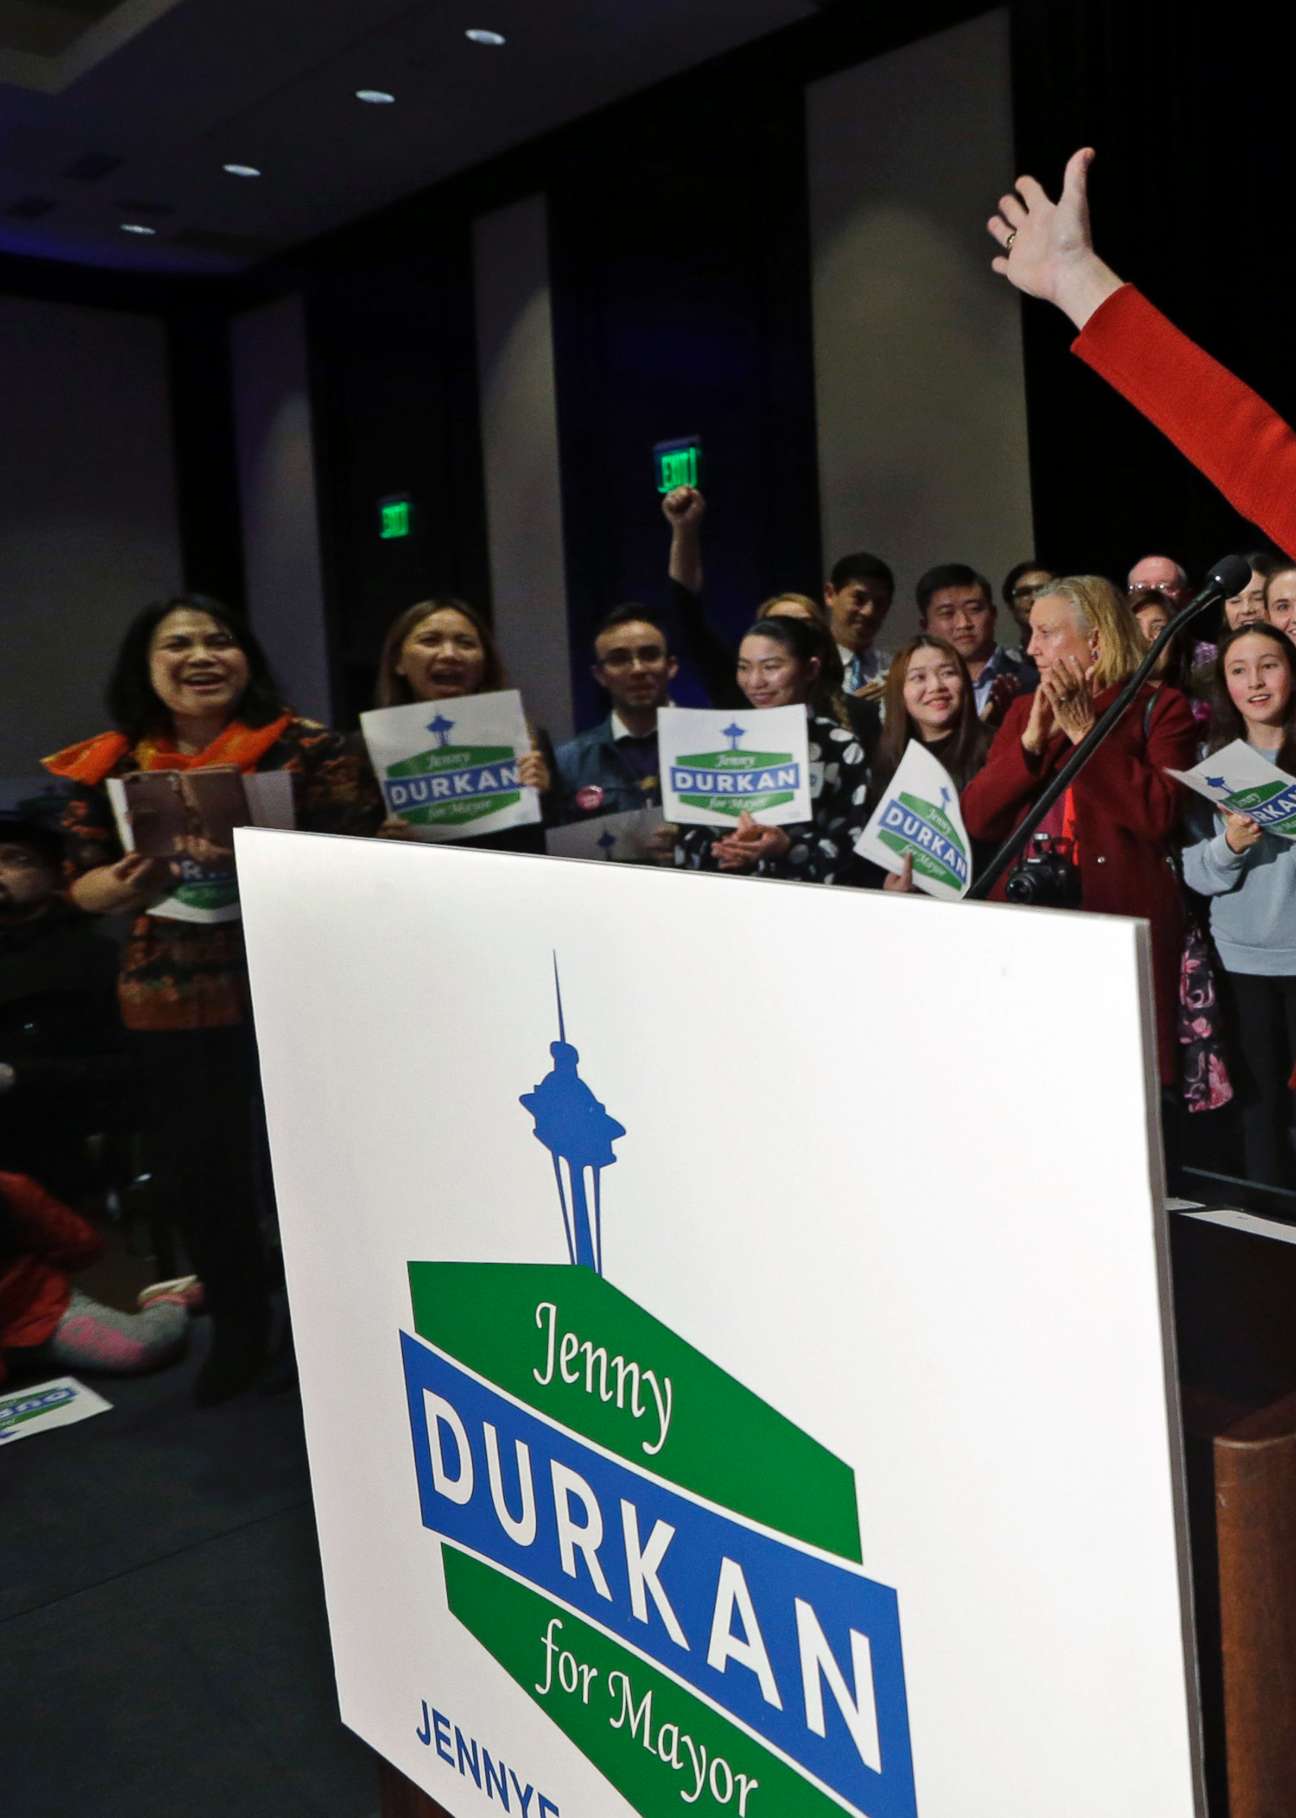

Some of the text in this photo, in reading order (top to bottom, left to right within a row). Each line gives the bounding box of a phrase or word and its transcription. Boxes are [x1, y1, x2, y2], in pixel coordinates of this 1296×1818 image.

[391, 768, 519, 804] DURKAN
[674, 768, 796, 792] DURKAN
[885, 806, 967, 878] DURKAN
[532, 1302, 672, 1455] Jenny
[421, 1386, 882, 1775] DURKAN
[534, 1618, 759, 1818] for Mayor
